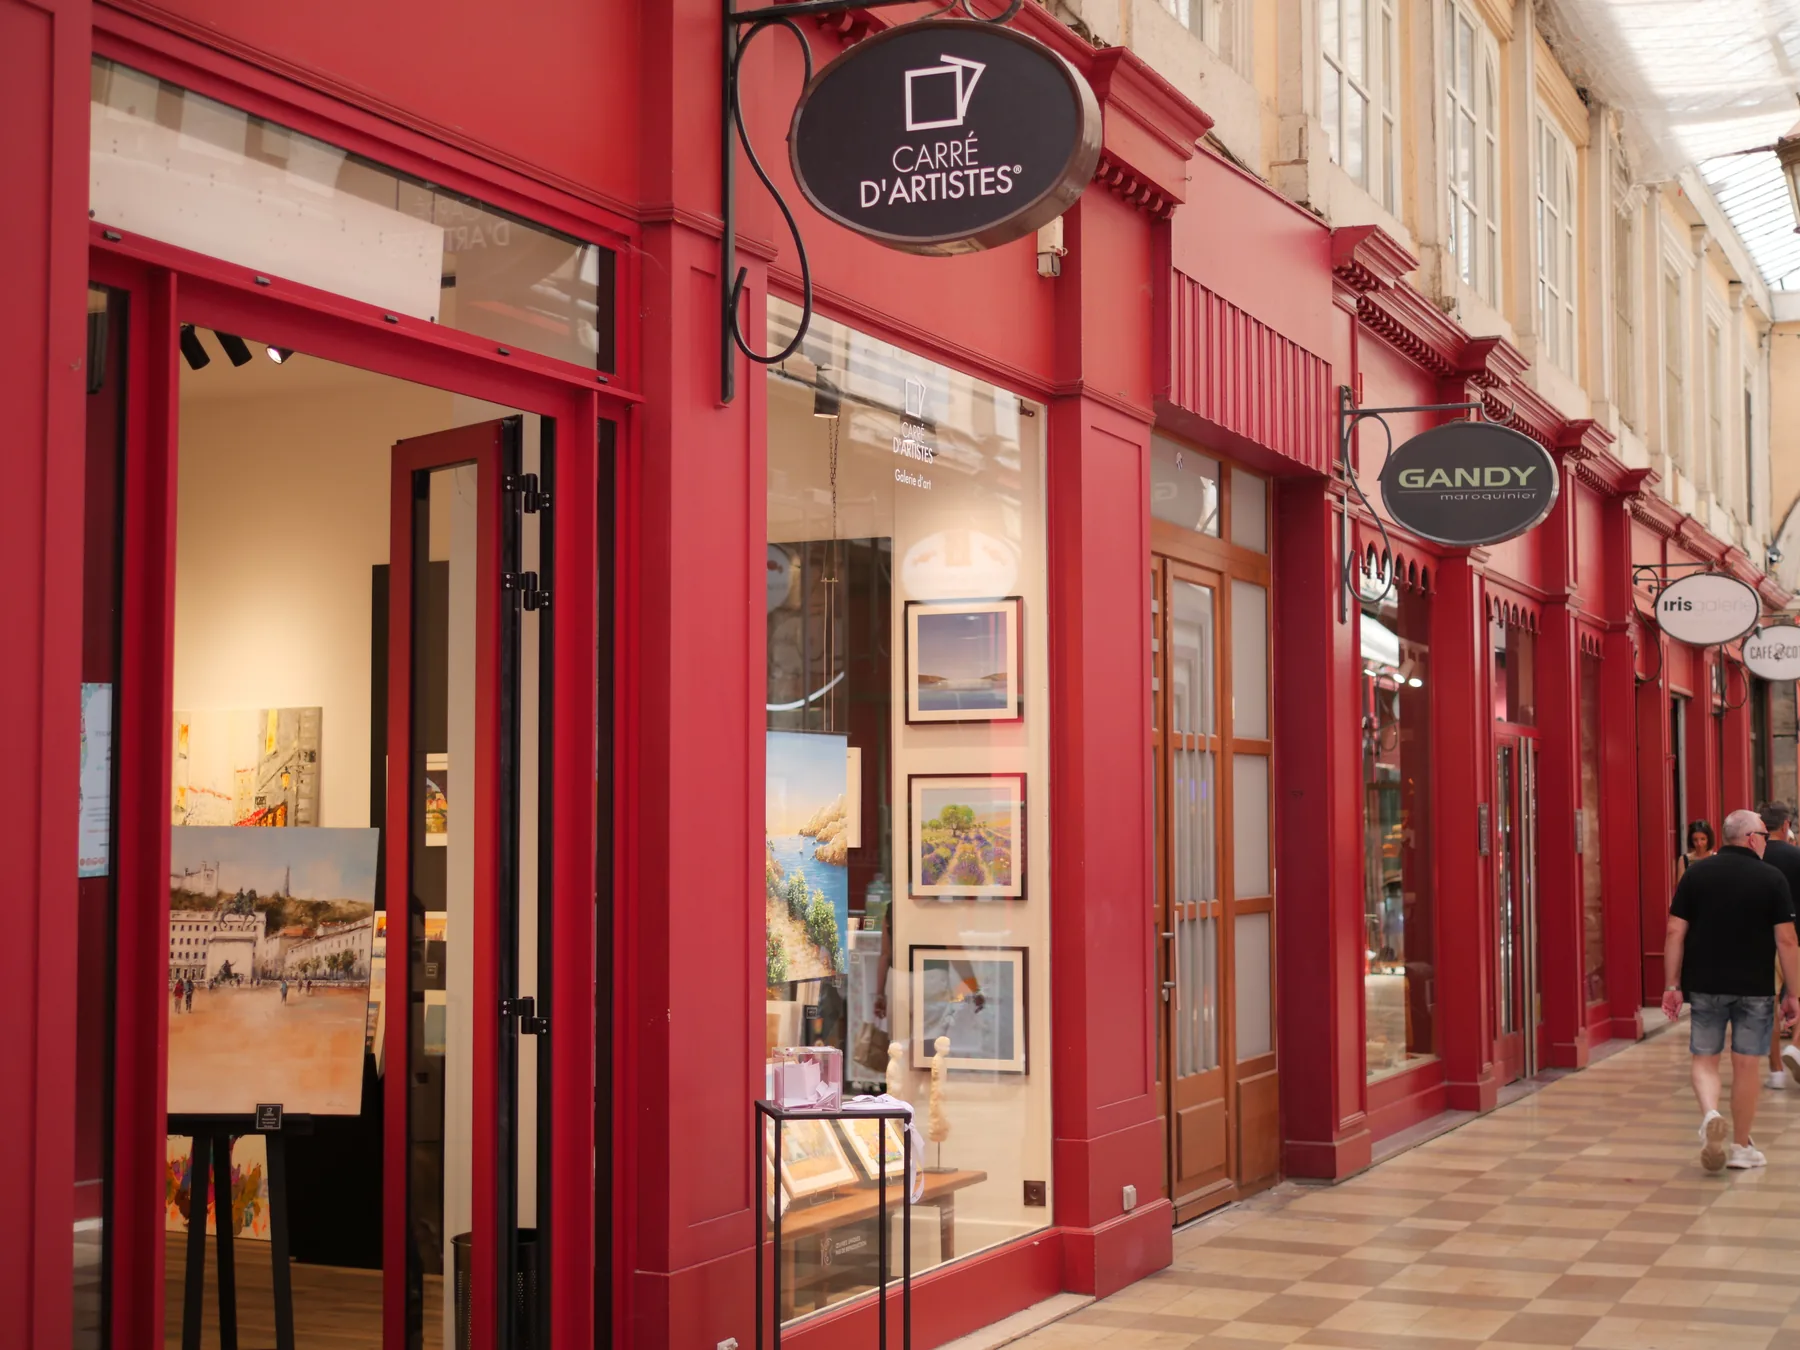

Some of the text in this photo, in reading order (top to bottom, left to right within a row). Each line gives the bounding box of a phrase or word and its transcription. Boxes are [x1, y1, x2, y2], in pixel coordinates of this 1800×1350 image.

[892, 131, 979, 173] CARRÉ
[902, 422, 925, 444] CARRÉ
[893, 437, 933, 464] D'ARTISTES
[895, 468, 932, 490] Galerie d'art
[1398, 466, 1537, 488] GANDY
[1440, 492, 1537, 501] maroquinier
